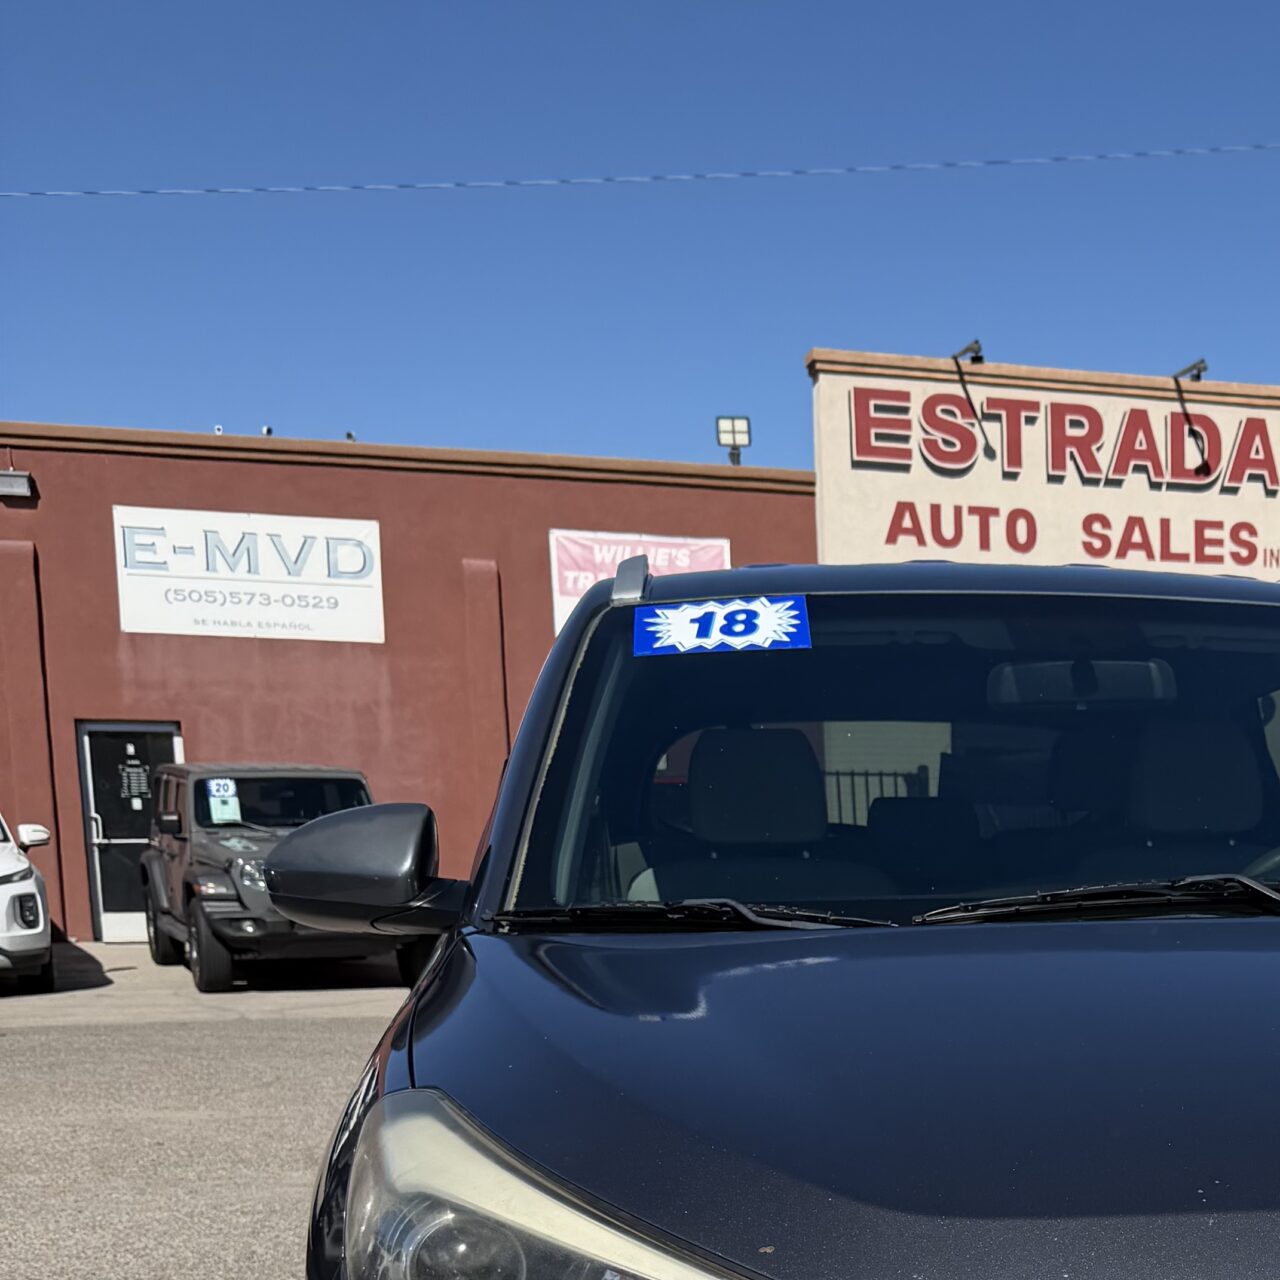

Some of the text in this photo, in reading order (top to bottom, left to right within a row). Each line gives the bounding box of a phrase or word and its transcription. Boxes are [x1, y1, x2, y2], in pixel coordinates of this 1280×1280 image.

[849, 386, 1280, 497] ESTRADA
[884, 500, 1038, 554] AUTO
[1081, 512, 1259, 566] SALES
[121, 525, 375, 580] E-MVD
[164, 587, 340, 610] (505)573-0529
[212, 618, 253, 629] HABLA
[690, 609, 760, 640] 18
[215, 783, 229, 793] 20
